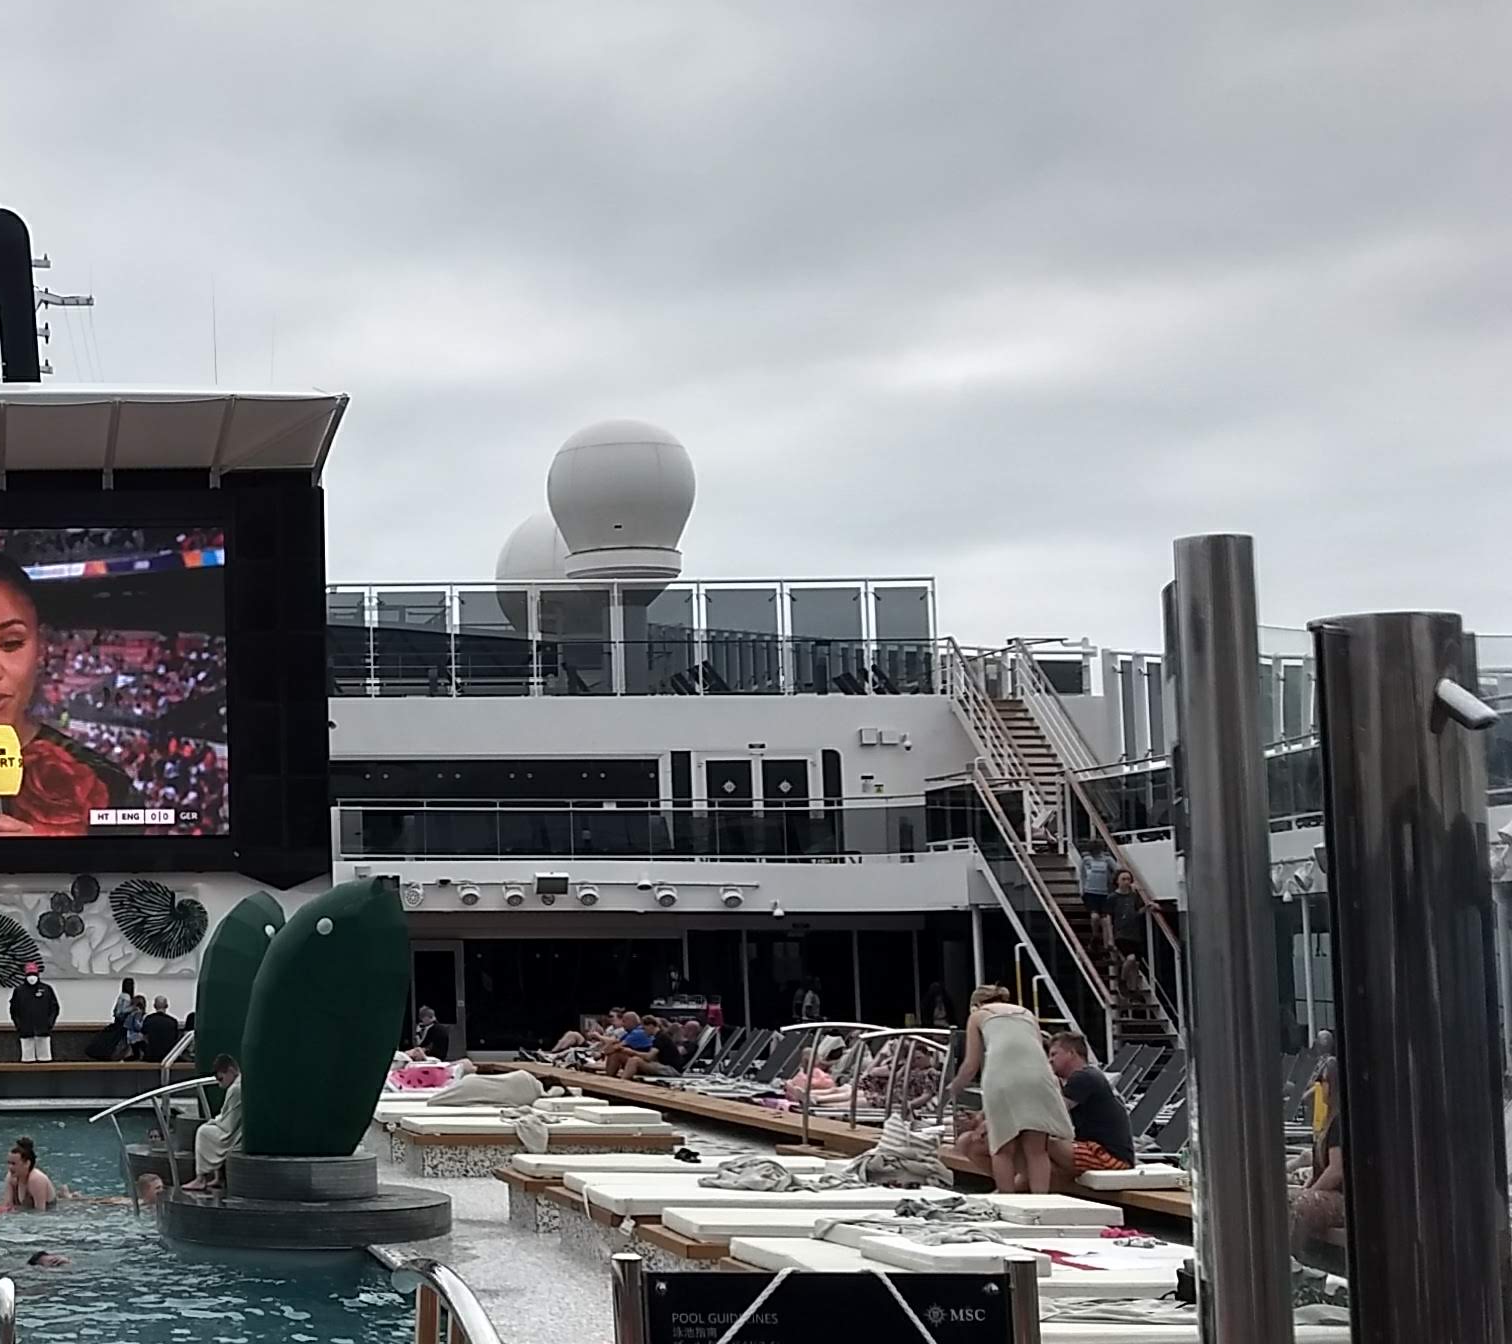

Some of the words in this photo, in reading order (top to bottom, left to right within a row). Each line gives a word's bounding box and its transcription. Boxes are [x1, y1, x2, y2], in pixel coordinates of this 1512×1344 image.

[97, 813, 109, 821] HT
[121, 812, 140, 821] ENG
[671, 1312, 705, 1324] POOL
[950, 1308, 987, 1322] MSC
